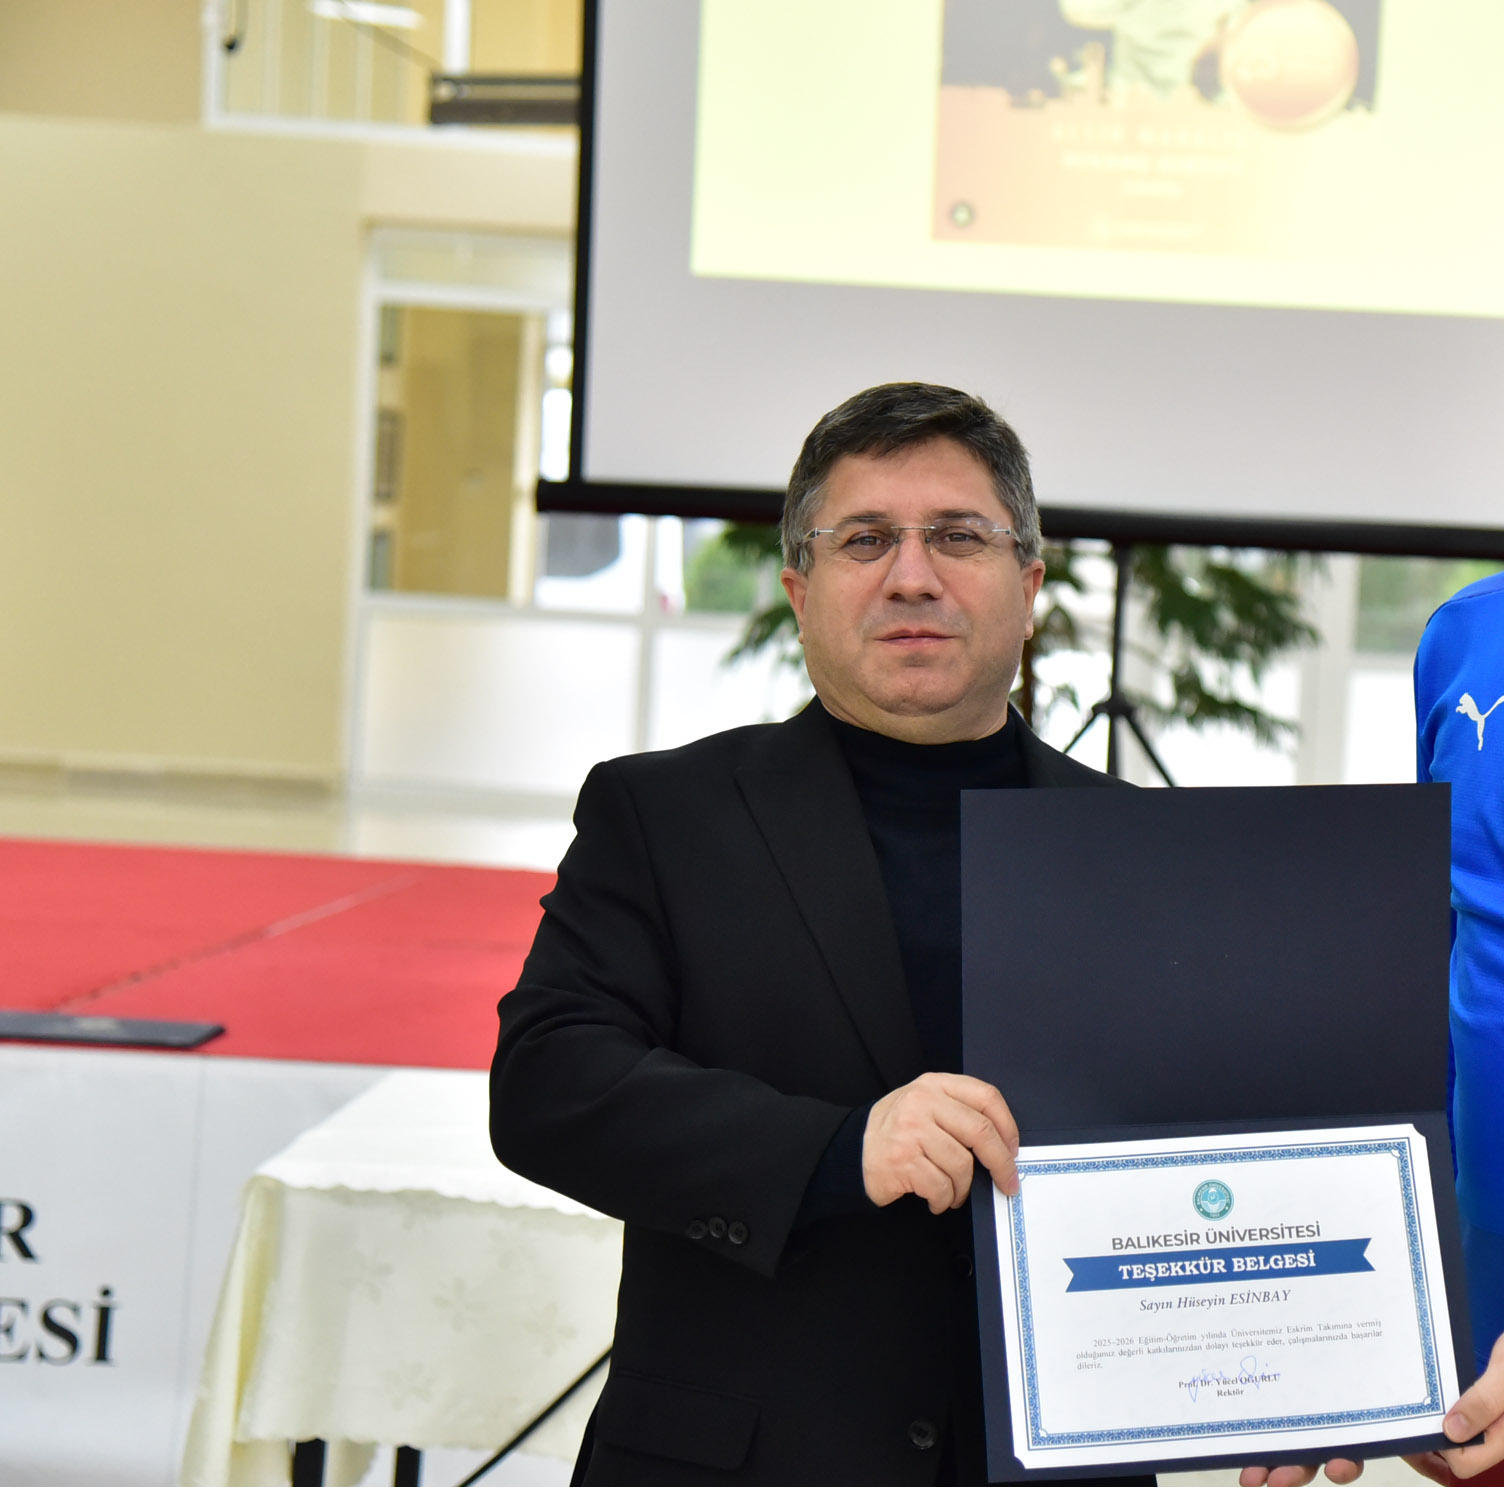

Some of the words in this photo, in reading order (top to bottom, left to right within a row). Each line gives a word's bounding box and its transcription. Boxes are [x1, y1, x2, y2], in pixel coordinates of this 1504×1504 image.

[1112, 1229, 1201, 1250] BALIKESİR
[1206, 1221, 1321, 1245] ÜNİVERSİTESİ
[1118, 1257, 1227, 1281] TEŞEKKÜR
[1232, 1249, 1316, 1272] BELGESİ
[1140, 1299, 1173, 1313] Sayın
[1177, 1296, 1225, 1310] Hüseyin
[1230, 1289, 1291, 1305] ESİNBAY
[1201, 1330, 1227, 1341] yılında
[1231, 1326, 1282, 1338] Üniversitemiz
[1287, 1324, 1313, 1334] Eskrim
[1317, 1321, 1352, 1332] Takımına
[1357, 1320, 1382, 1329] vermiş
[1076, 1348, 1115, 1360] olduğunuz
[1118, 1346, 1144, 1357] değerli
[1205, 1341, 1229, 1351] dolayı
[1232, 1338, 1263, 1350] teşekkür
[1266, 1337, 1285, 1346] eder,
[1288, 1334, 1348, 1346] çalışmalarınızda
[1351, 1330, 1383, 1340] başarılar
[1077, 1361, 1103, 1370] dileriz.
[1200, 1378, 1214, 1388] Dr.
[1216, 1376, 1238, 1387] Yücel
[1217, 1389, 1244, 1398] Rektör
